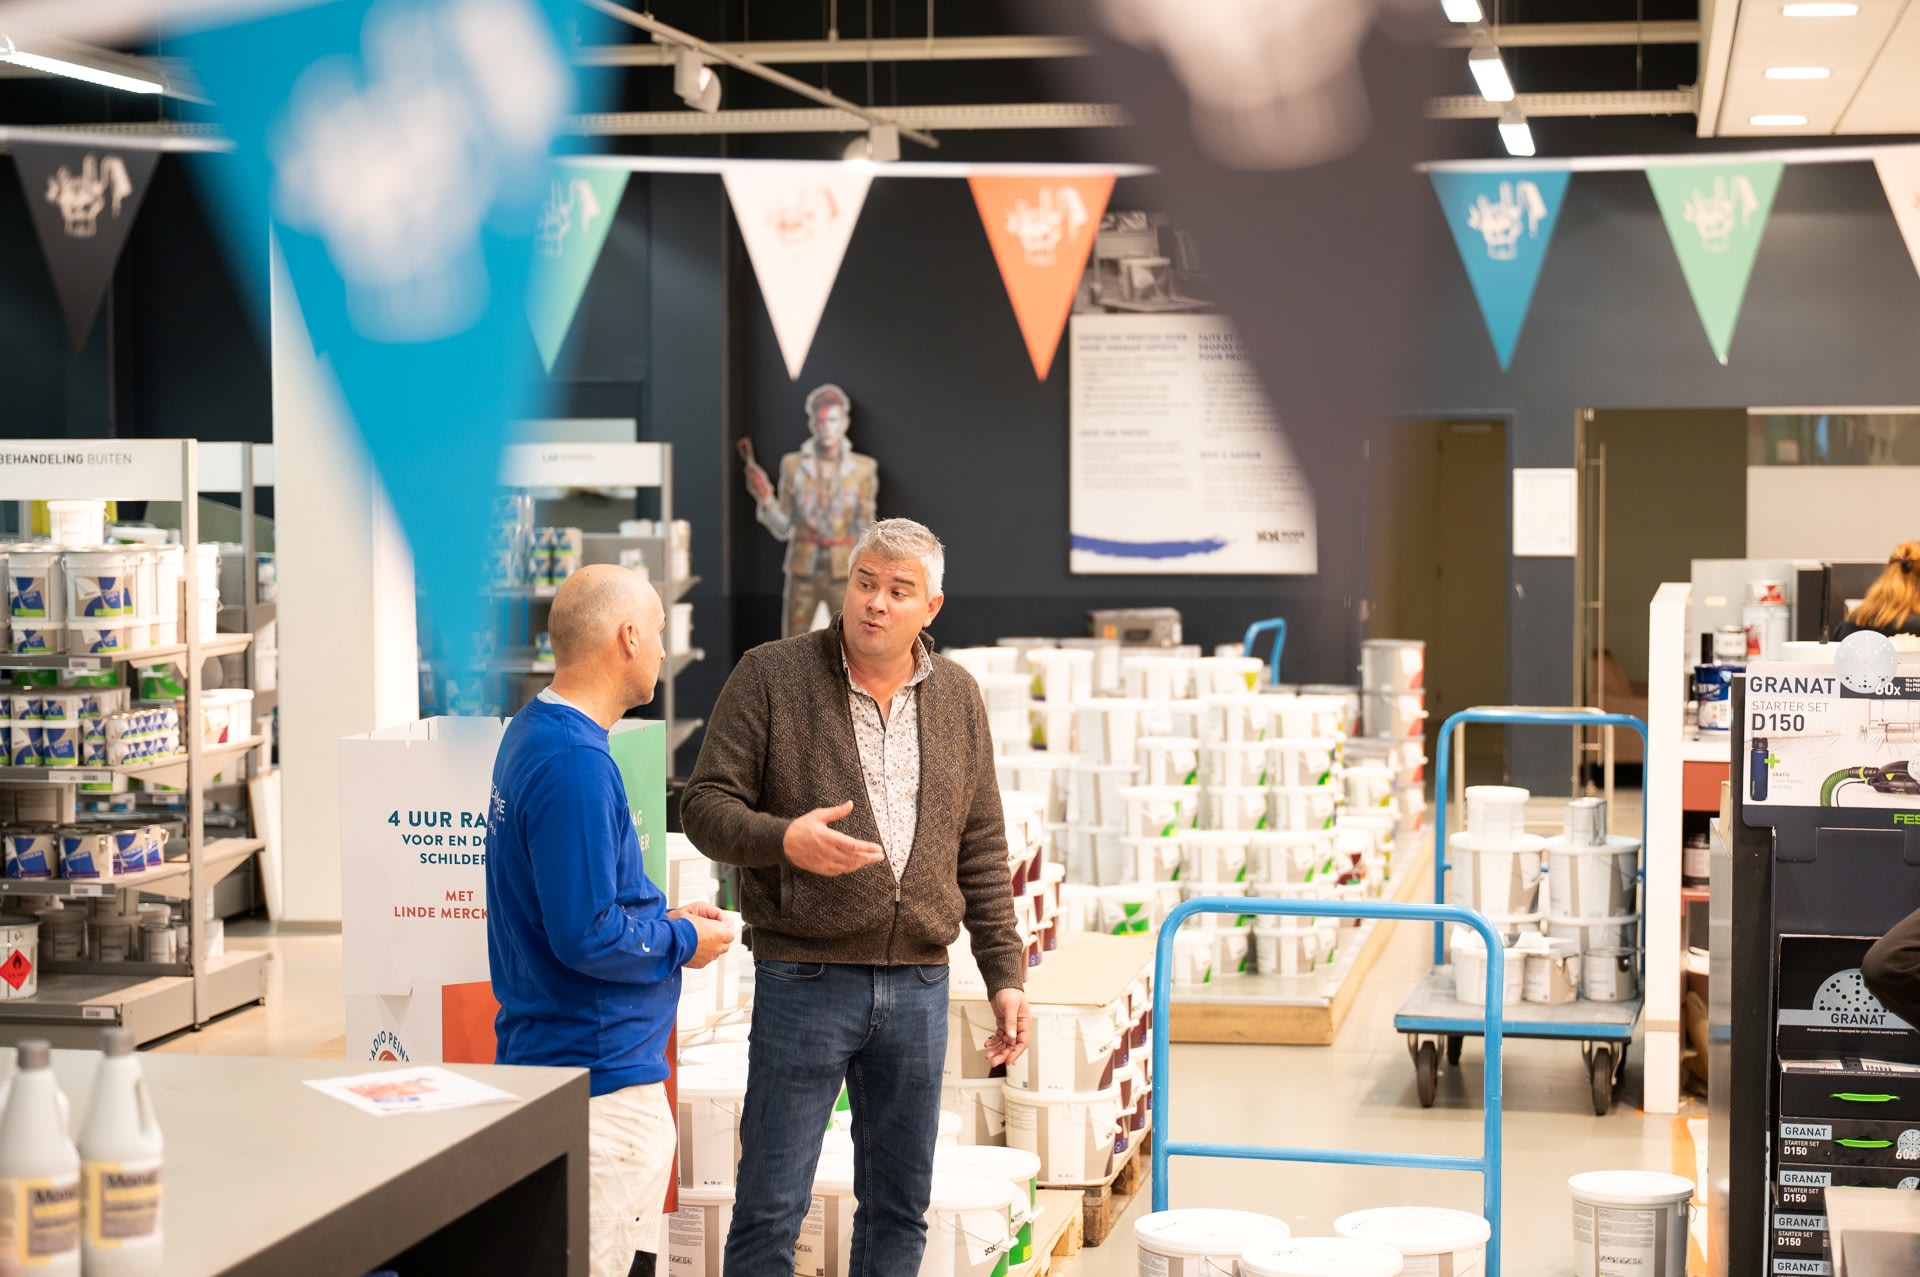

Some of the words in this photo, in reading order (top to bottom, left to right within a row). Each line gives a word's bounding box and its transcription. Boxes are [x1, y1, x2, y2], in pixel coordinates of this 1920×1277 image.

[87, 453, 132, 465] BUITEN
[1750, 676, 1836, 694] GRANAT
[1875, 682, 1900, 696] 60x
[1752, 701, 1804, 712] STARTER
[1807, 702, 1829, 712] SET
[1752, 713, 1804, 732] D150
[388, 810, 400, 826] 4
[408, 810, 452, 828] UUR
[402, 834, 444, 846] VOOR
[448, 835, 467, 847] EN
[446, 890, 474, 902] MET
[394, 906, 436, 918] LINDE
[1830, 1013, 1886, 1025] GRANAT
[369, 1030, 386, 1061] ADIO
[1785, 1126, 1827, 1137] GRANAT
[1784, 1146, 1807, 1156] D150
[1784, 1174, 1826, 1184] GRANAT
[1783, 1194, 1807, 1203] D150
[1778, 1217, 1821, 1227] GRANAT
[1778, 1237, 1801, 1246] D150
[1777, 1262, 1820, 1272] GRANAT
